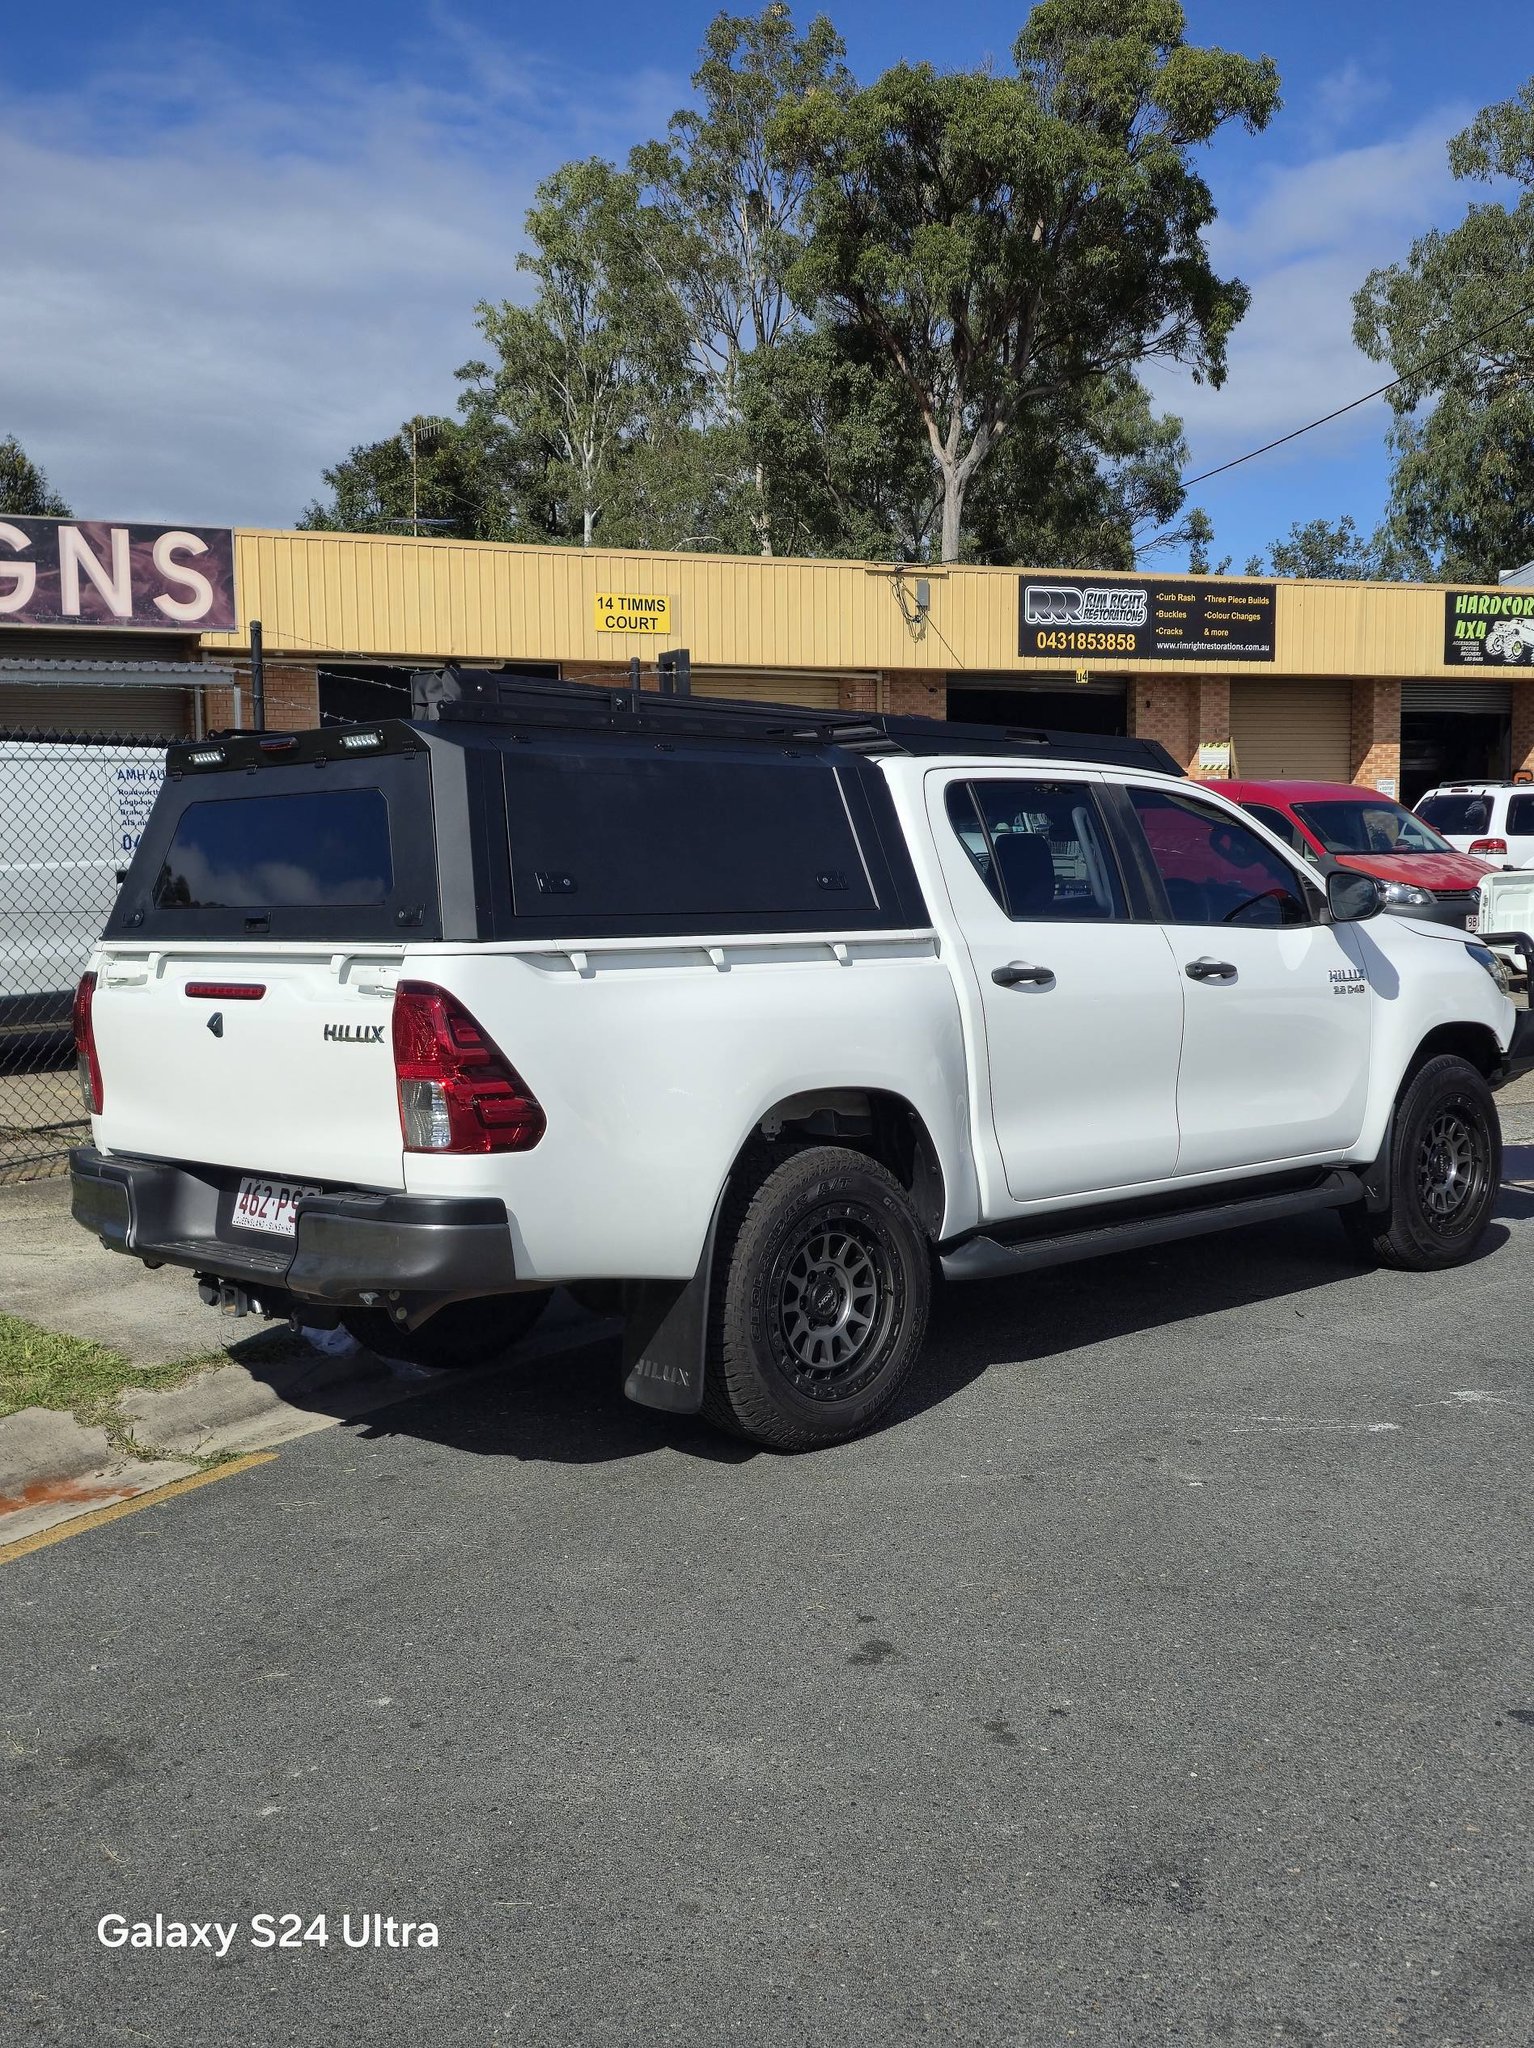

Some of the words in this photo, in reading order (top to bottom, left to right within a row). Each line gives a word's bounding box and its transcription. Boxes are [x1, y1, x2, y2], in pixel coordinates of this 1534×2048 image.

[597, 596, 614, 609] 14
[618, 597, 666, 612] TIMMS
[1085, 592, 1107, 608] RIM
[1110, 593, 1144, 609] RIGHT
[1178, 593, 1196, 602] Rash
[1228, 596, 1246, 604] Piece
[1248, 596, 1270, 605] Builds
[1083, 608, 1144, 622] RESTORATIONS
[1231, 612, 1261, 622] Changes
[605, 615, 658, 630] COURT
[1204, 627, 1209, 636] &
[1211, 629, 1229, 637] more
[1037, 631, 1136, 651] 0431853858
[1156, 641, 1270, 651] www.rimrightrestorations.com.au
[323, 1023, 386, 1044] HILUX
